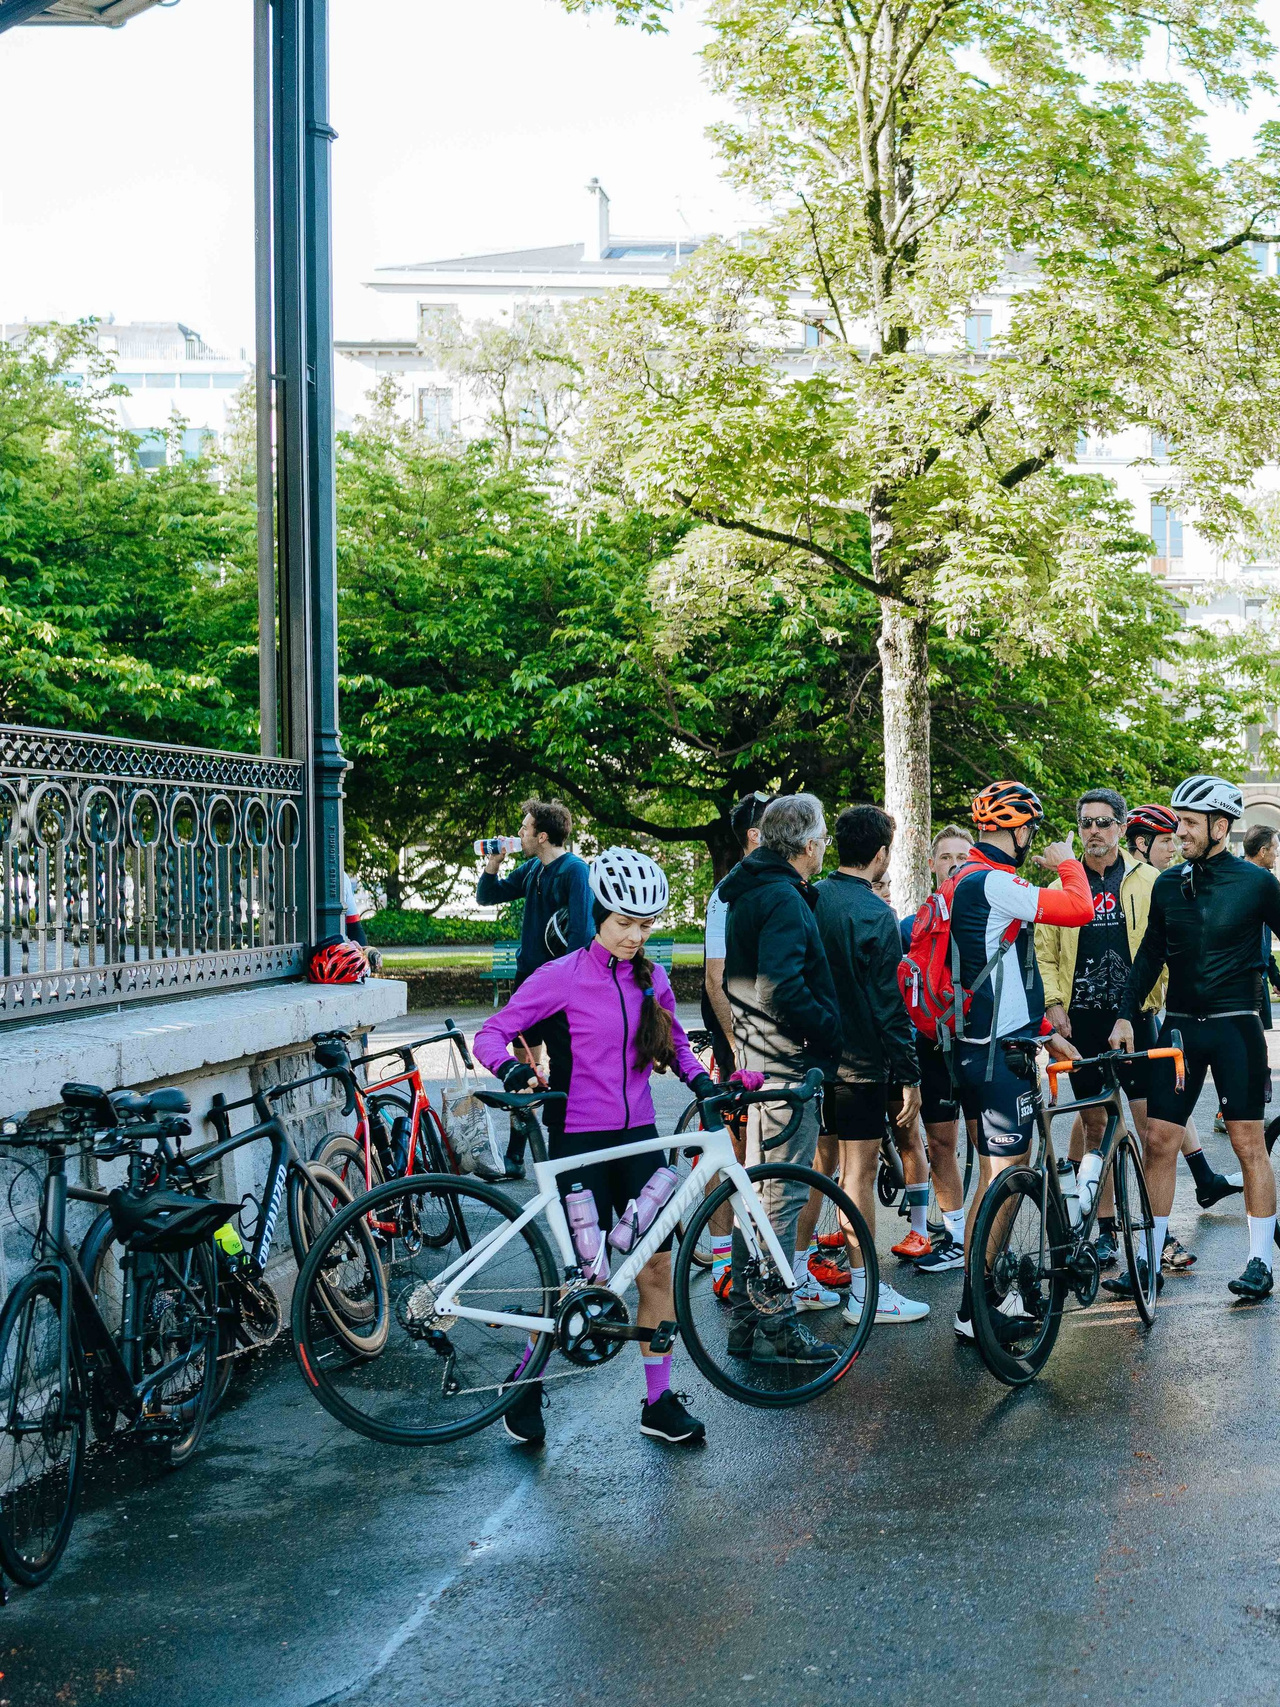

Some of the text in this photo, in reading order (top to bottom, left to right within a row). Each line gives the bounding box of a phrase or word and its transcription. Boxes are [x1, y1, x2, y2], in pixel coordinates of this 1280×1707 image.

[1212, 798, 1242, 816] S-WORKS
[258, 1164, 288, 1269] SPECIALIZED
[622, 1168, 707, 1281] SPECIALIZED
